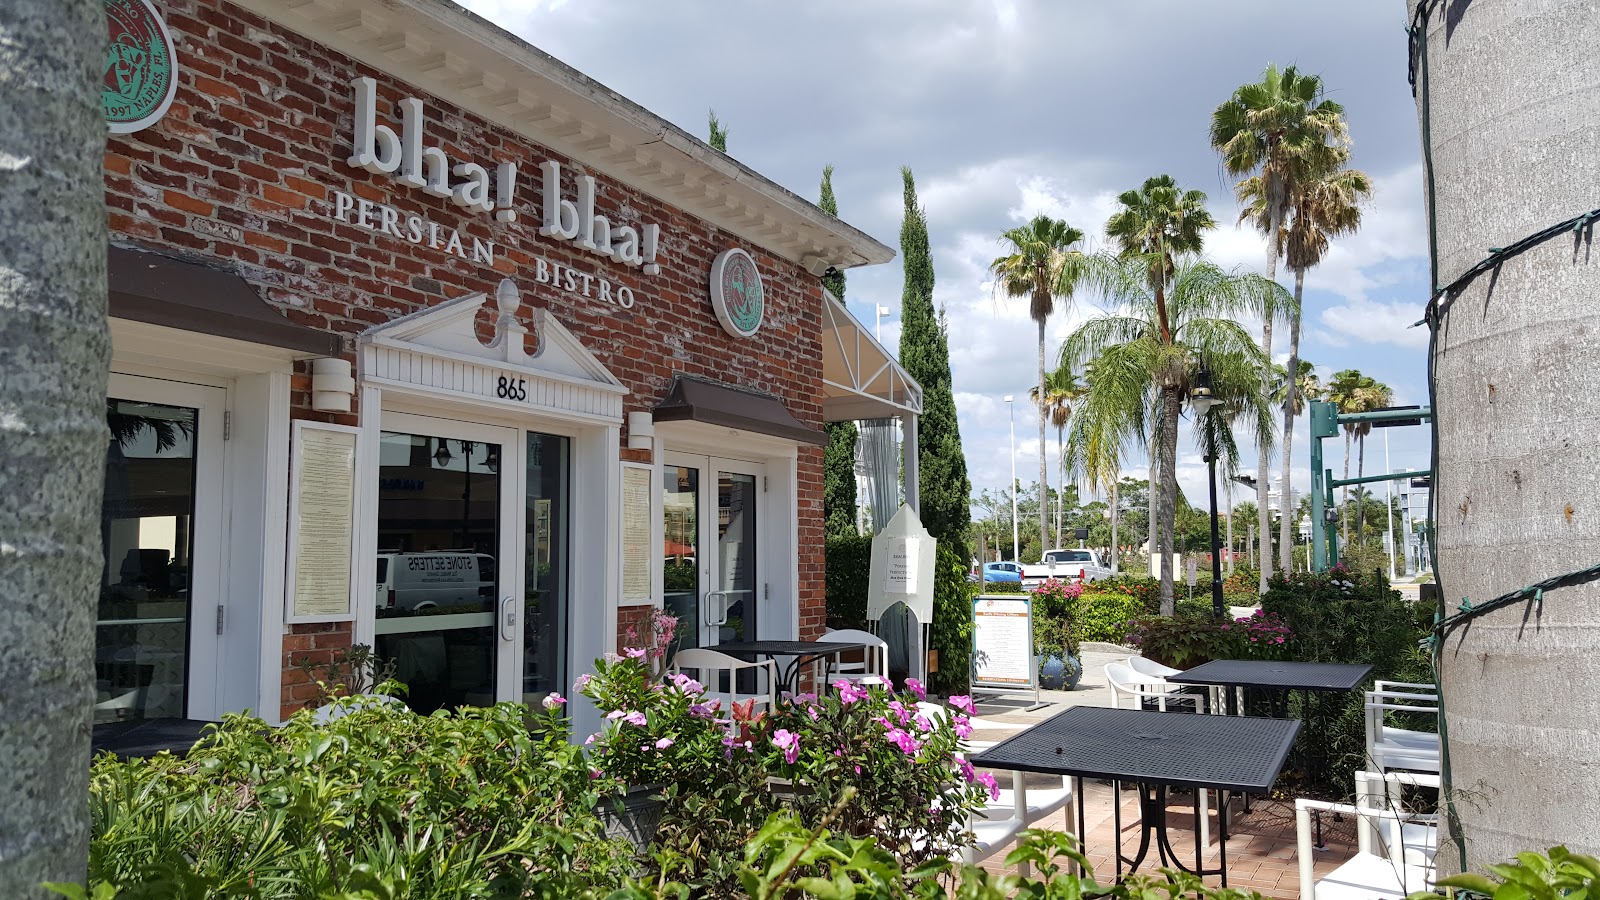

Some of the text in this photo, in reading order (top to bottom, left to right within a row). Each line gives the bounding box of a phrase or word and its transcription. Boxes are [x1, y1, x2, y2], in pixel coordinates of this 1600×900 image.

[104, 51, 165, 117] 1997 NAPLES, FL
[346, 76, 660, 276] bha! bha!
[334, 190, 635, 310] PERSIAN BISTRO
[497, 376, 526, 401] 865
